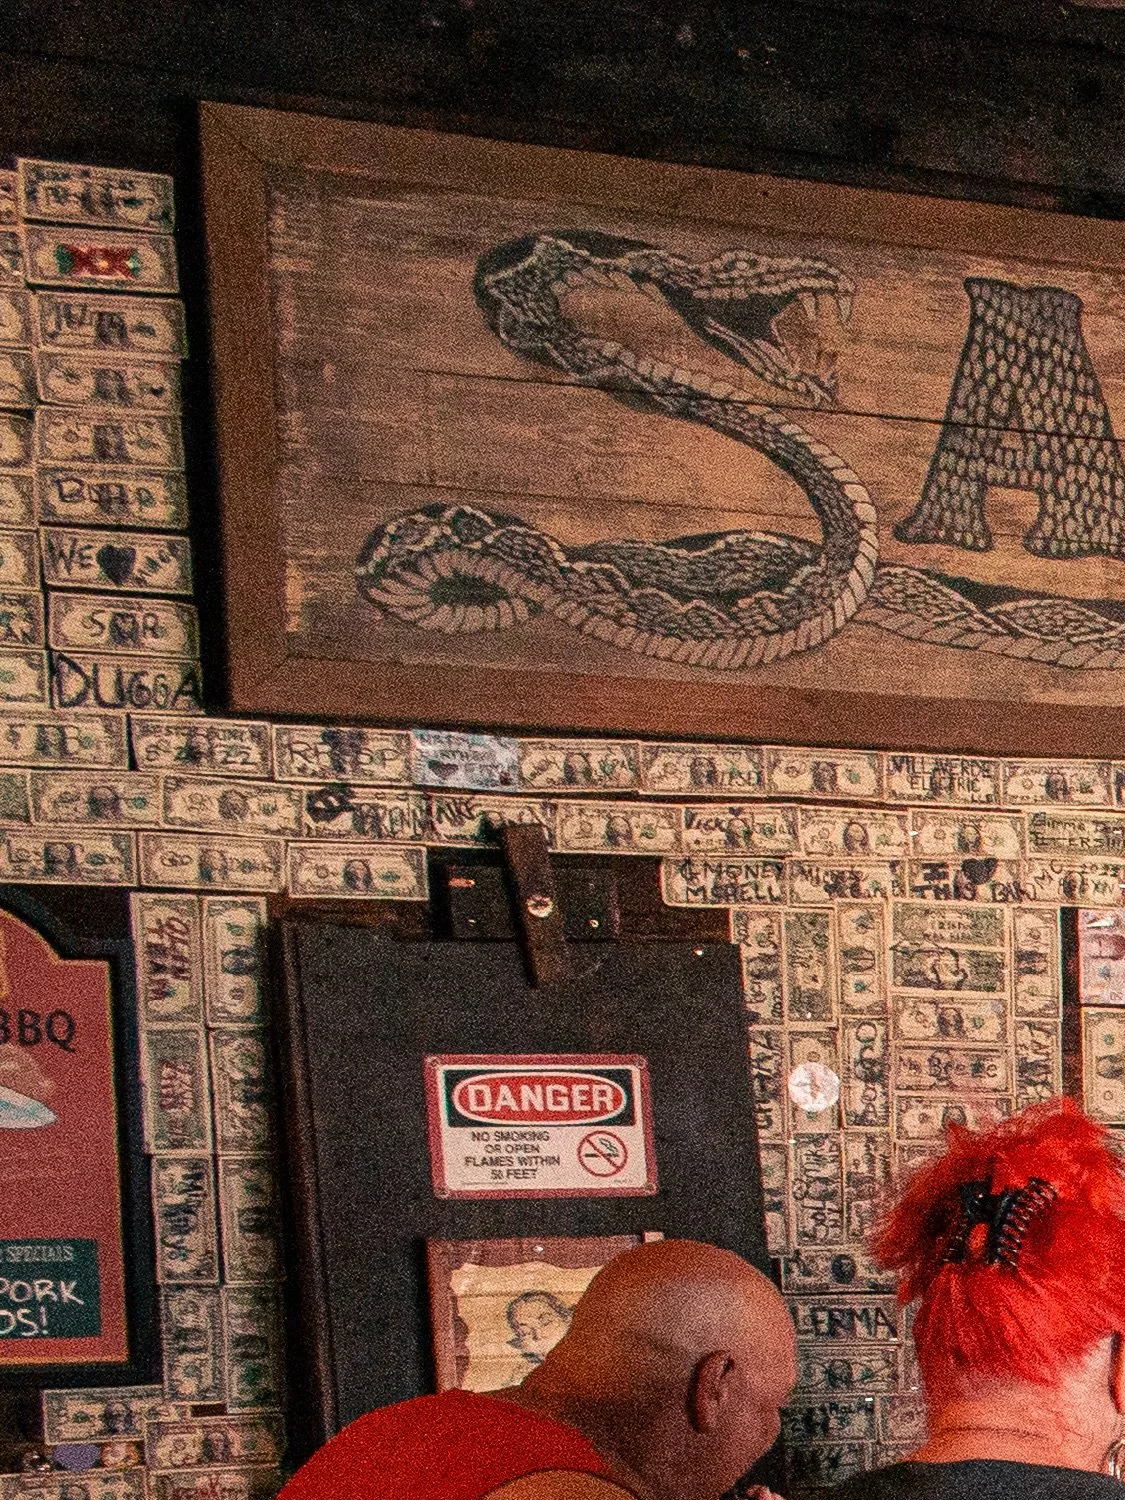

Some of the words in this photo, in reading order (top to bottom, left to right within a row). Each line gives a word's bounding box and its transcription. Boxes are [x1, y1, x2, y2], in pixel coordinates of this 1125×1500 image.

[467, 1084, 615, 1112] DANGER
[471, 1131, 490, 1143] NO
[493, 1131, 550, 1142] SMOKING
[484, 1144, 502, 1154] OR
[503, 1144, 540, 1154] OPEN
[464, 1156, 514, 1167] FLAMES
[517, 1155, 561, 1166] WITHIN
[506, 1168, 538, 1179] FEET
